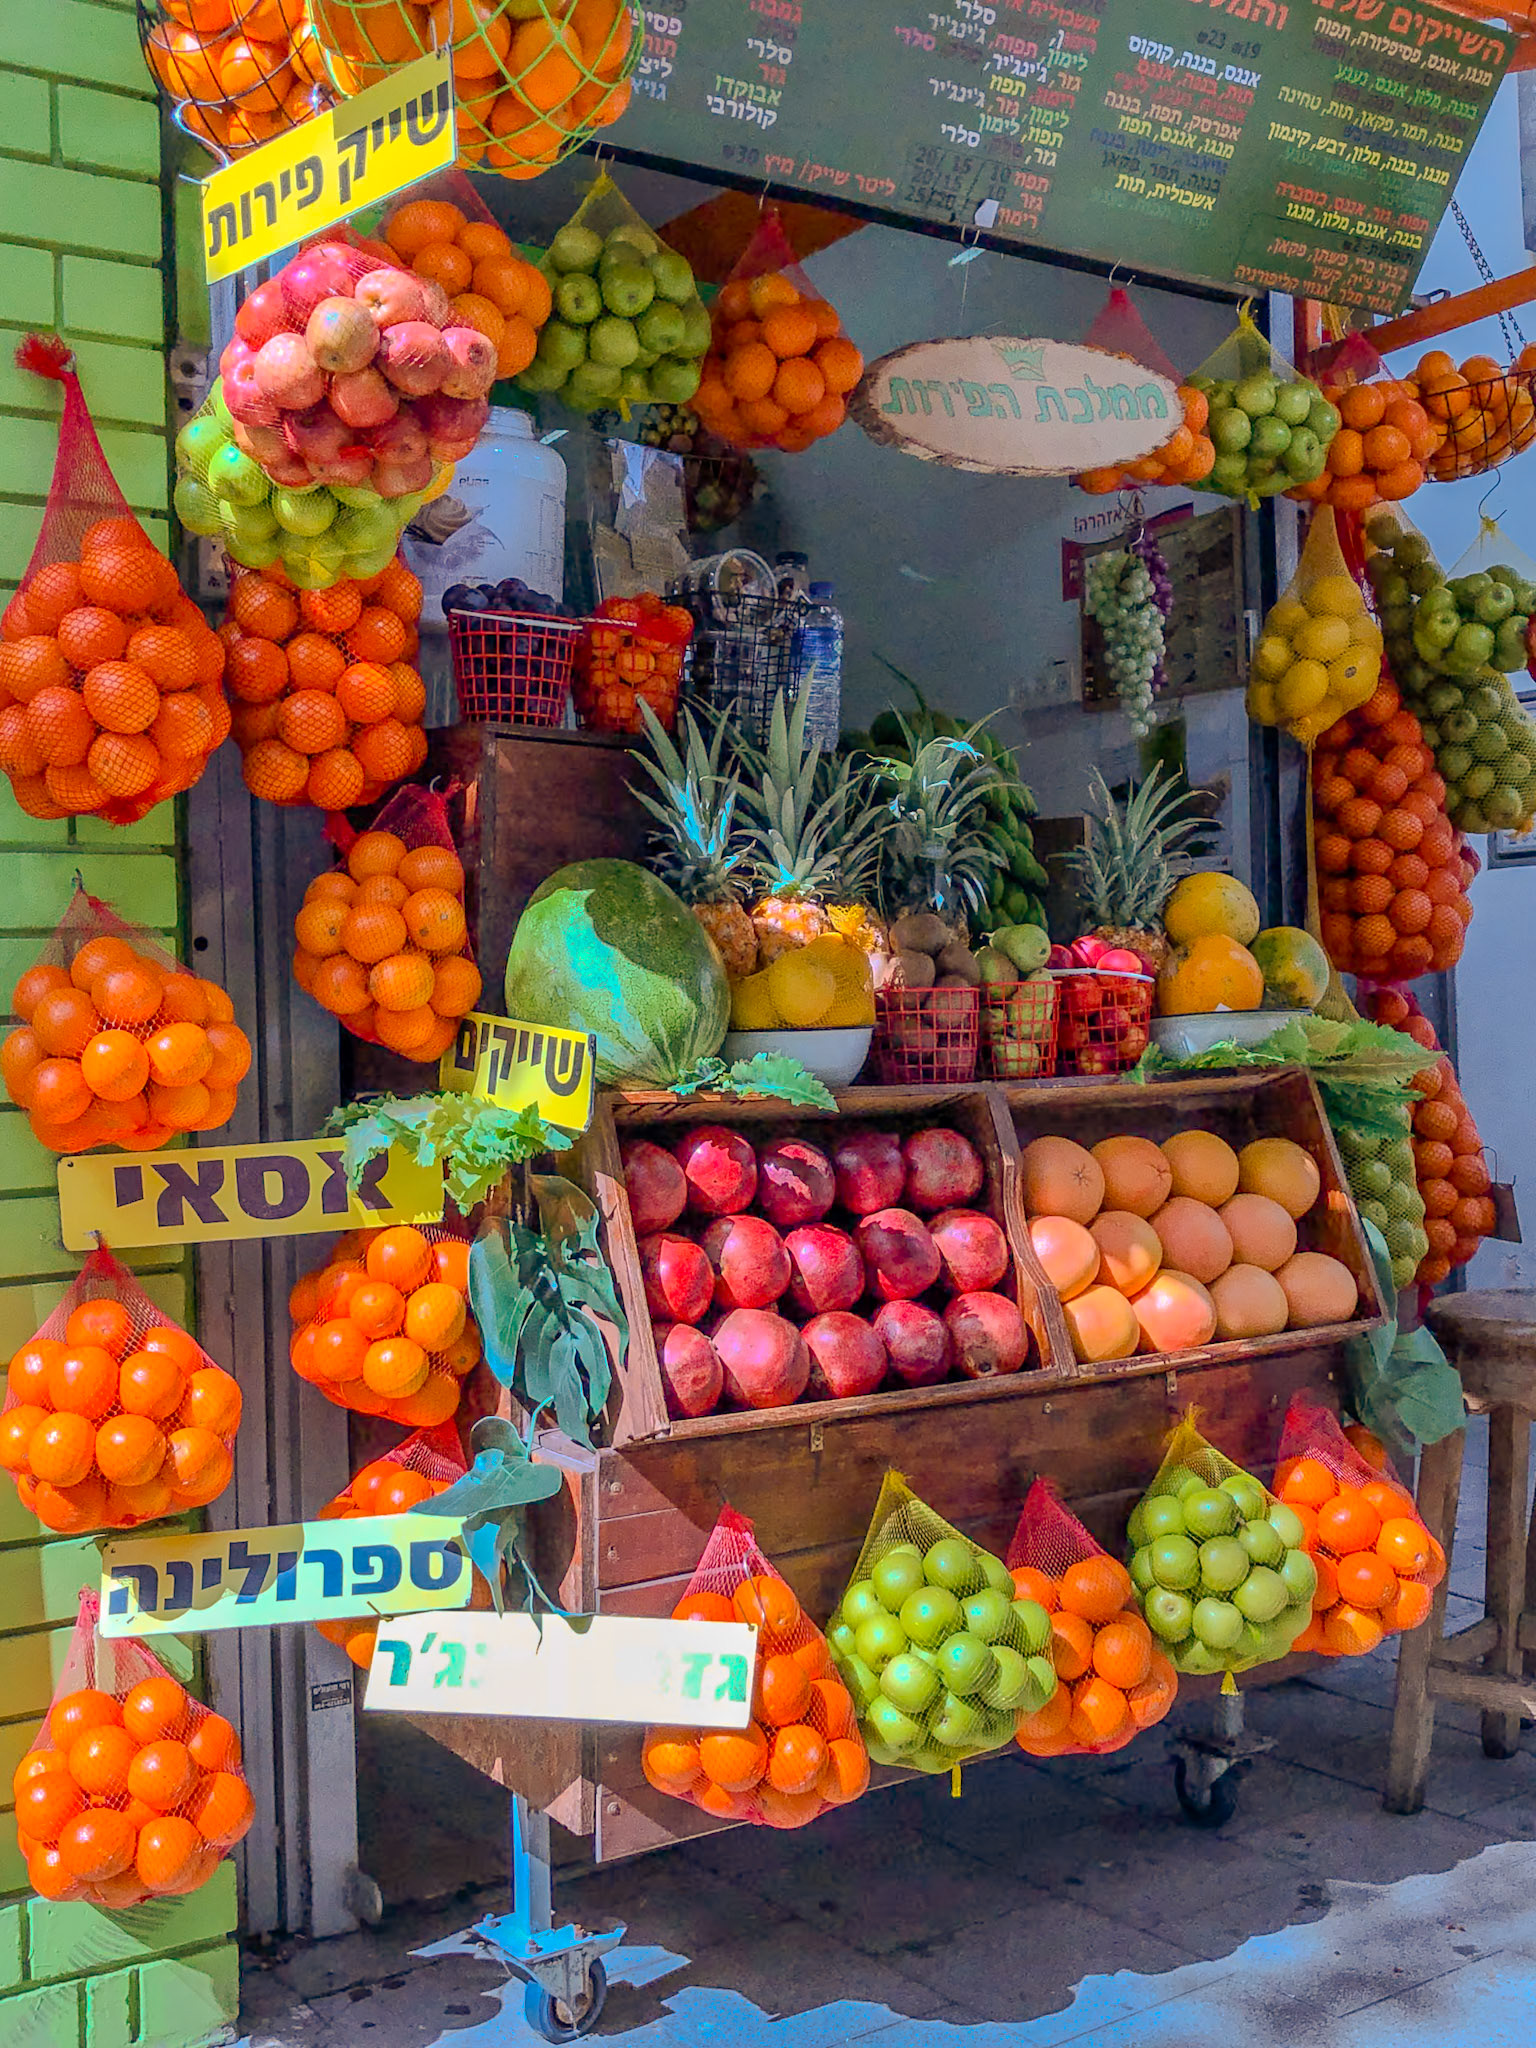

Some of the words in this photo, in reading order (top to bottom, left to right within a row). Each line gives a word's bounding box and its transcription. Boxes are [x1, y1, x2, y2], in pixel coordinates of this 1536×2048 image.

[954, 0, 997, 26] סלרי
[1313, 15, 1351, 41] תפוח
[1386, 6, 1505, 64] השייקים
[746, 37, 793, 65] סלרי
[1127, 33, 1174, 65] קוקוס
[1172, 50, 1217, 76] בננה,
[1421, 54, 1461, 77] אננס,
[989, 74, 1027, 97] תפוז
[1217, 63, 1261, 89] אננס,
[1459, 65, 1494, 87] מנגו,
[715, 75, 783, 107] אבוקדו
[1104, 90, 1142, 115] בננה
[1277, 85, 1322, 112] טחינה
[705, 94, 778, 130] קולורבי
[1020, 105, 1070, 129] לימון,
[1143, 103, 1182, 125] תפוז,
[1320, 100, 1355, 120] תות,
[940, 122, 981, 148] סלרי
[978, 112, 1020, 137] לימון
[1118, 114, 1152, 138] תפוז
[1184, 115, 1242, 142] אפרסק,
[1267, 120, 1313, 149] קינמון
[1354, 110, 1395, 137] פקאן,
[1392, 122, 1429, 143] תמר,
[337, 80, 450, 206] שייק
[1020, 126, 1064, 148] תפוז,
[1153, 126, 1197, 150] אננס,
[1196, 137, 1235, 160] מנגו,
[1310, 134, 1347, 158] דבש,
[1426, 132, 1464, 154] בננה,
[1023, 147, 1057, 167] גזר,
[1344, 144, 1381, 168] מלון,
[1379, 154, 1418, 178] בננה,
[1114, 173, 1146, 195] תות
[1416, 165, 1450, 187] מנגו,
[207, 154, 324, 258] פירות
[1145, 183, 1217, 211] אשכולית,
[1285, 201, 1316, 224] מנגו
[1314, 209, 1350, 231] מלון,
[1349, 219, 1389, 242] אננס,
[1386, 229, 1422, 250] בננה,
[881, 375, 1022, 420] הפירות
[1035, 373, 1169, 424] ממלכת
[1074, 509, 1122, 533] אזהרה!
[455, 1018, 586, 1097] שייקים
[114, 1151, 393, 1228] אסאי
[107, 1539, 467, 1616] ספרולינה
